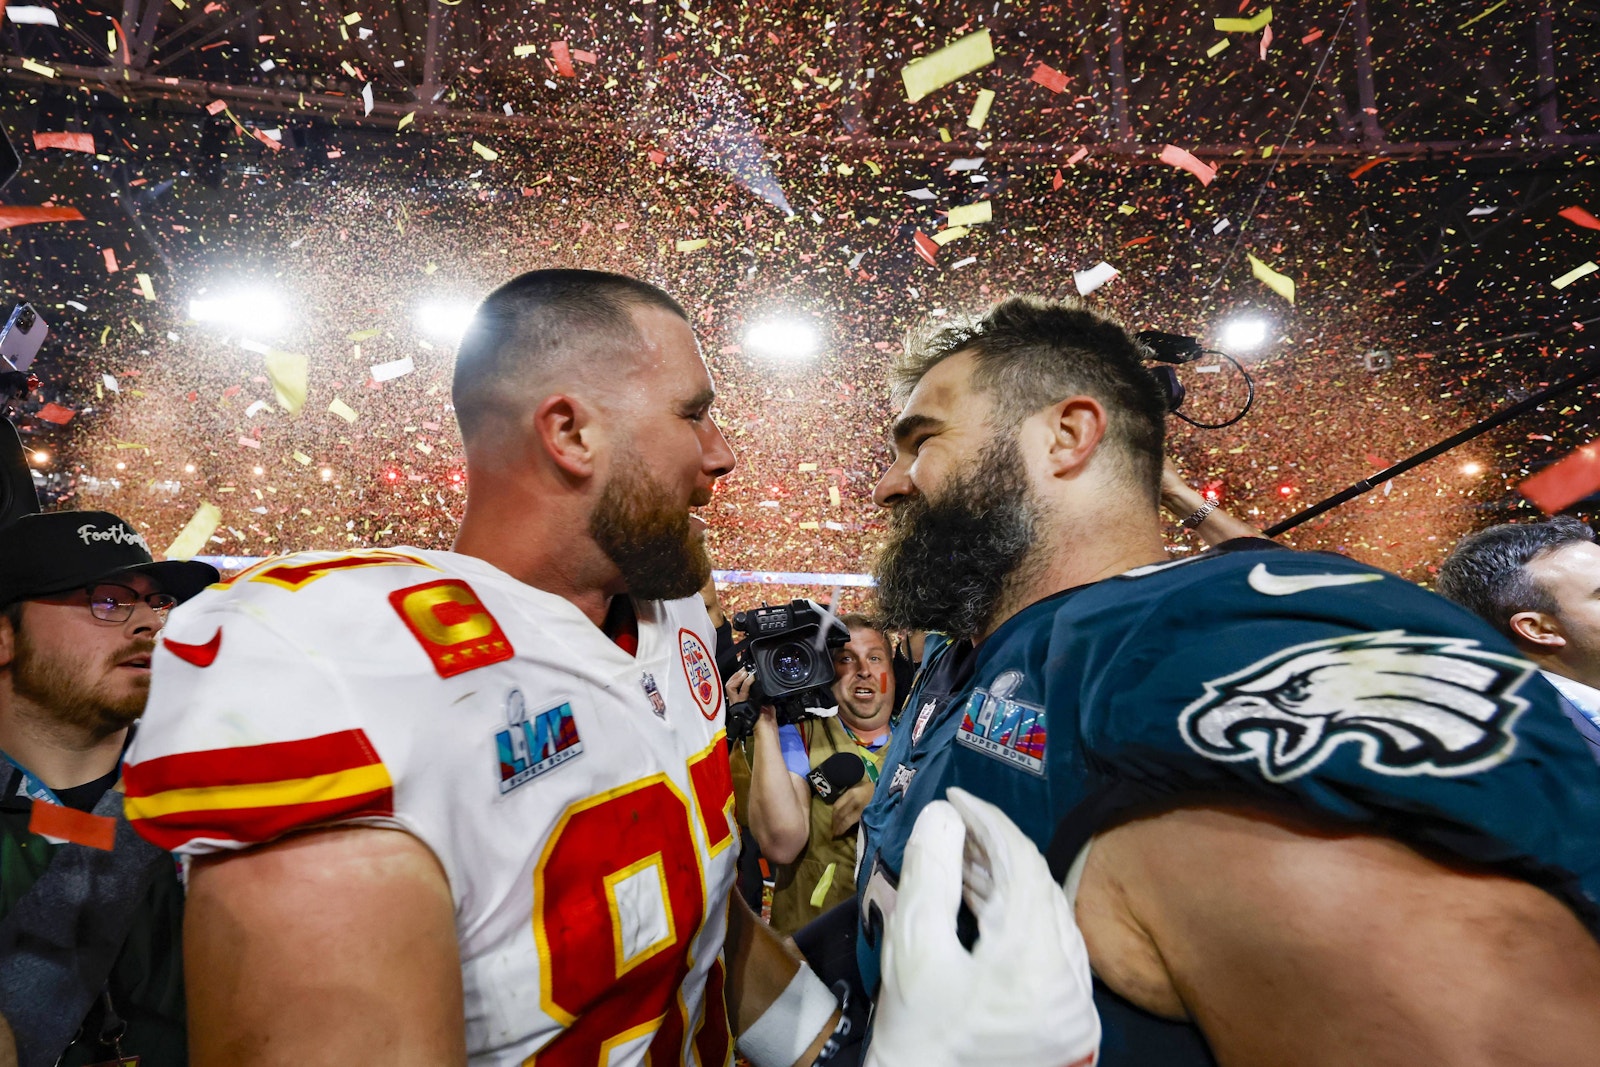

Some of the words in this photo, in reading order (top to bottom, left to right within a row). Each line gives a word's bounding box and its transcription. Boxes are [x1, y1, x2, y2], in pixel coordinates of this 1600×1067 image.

[77, 523, 151, 555] Footb
[402, 584, 493, 646] C
[509, 763, 544, 786] SUPER
[548, 747, 576, 766] BOWL
[964, 732, 998, 752] SUPER
[1002, 748, 1033, 767] BOWL
